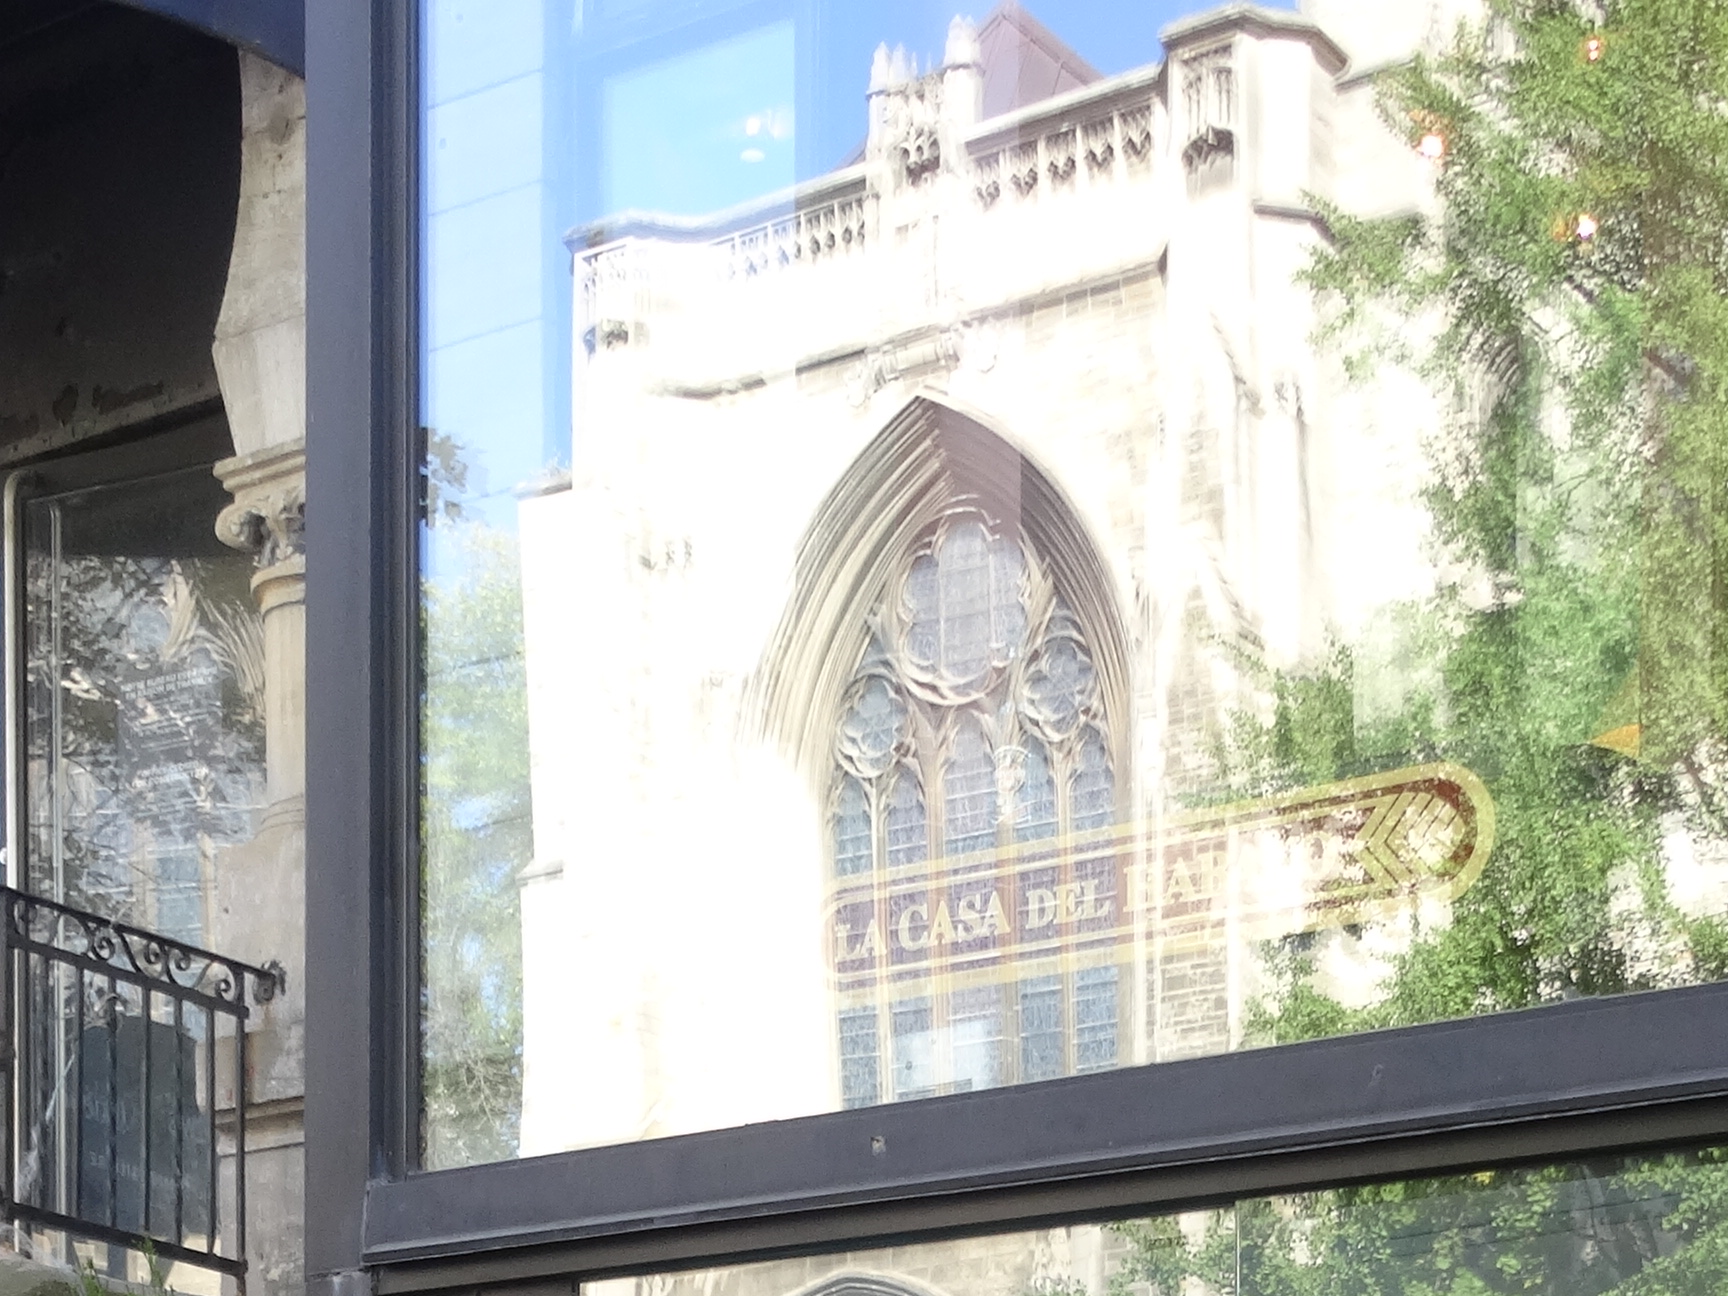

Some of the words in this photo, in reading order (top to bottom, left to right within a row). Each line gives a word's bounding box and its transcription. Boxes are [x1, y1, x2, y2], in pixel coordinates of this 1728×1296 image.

[833, 919, 888, 963] LA
[897, 891, 1011, 952] CASA
[1024, 878, 1114, 932] DEL
